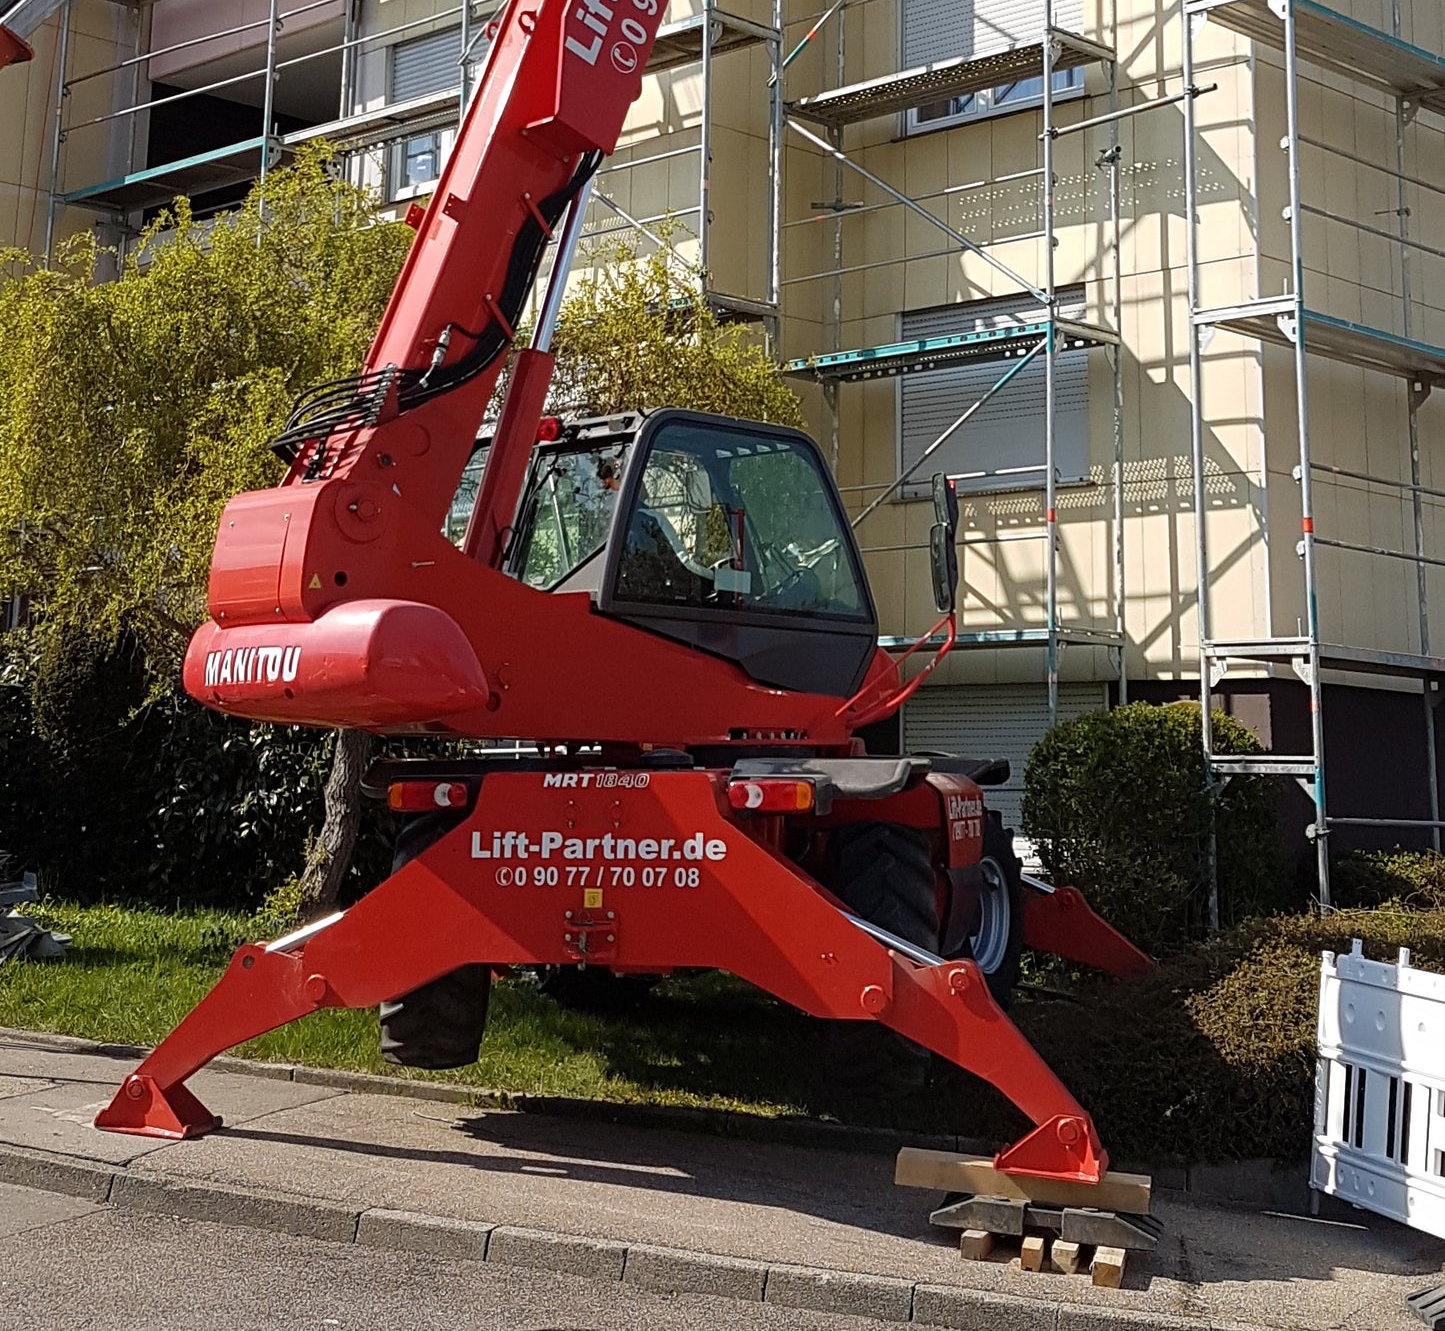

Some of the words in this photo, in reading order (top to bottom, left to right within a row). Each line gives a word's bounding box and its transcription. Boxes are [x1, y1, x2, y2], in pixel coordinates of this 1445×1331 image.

[621, 18, 647, 45] 0
[205, 646, 302, 686] MANITOU
[543, 773, 595, 788] MRT
[595, 772, 650, 788] 1840
[471, 831, 727, 861] Lift-Partner.de
[514, 866, 527, 886] 0
[533, 866, 559, 886] 90
[565, 866, 591, 886] 77
[610, 866, 636, 887] 70
[641, 867, 668, 887] 07
[674, 867, 700, 888] 08
